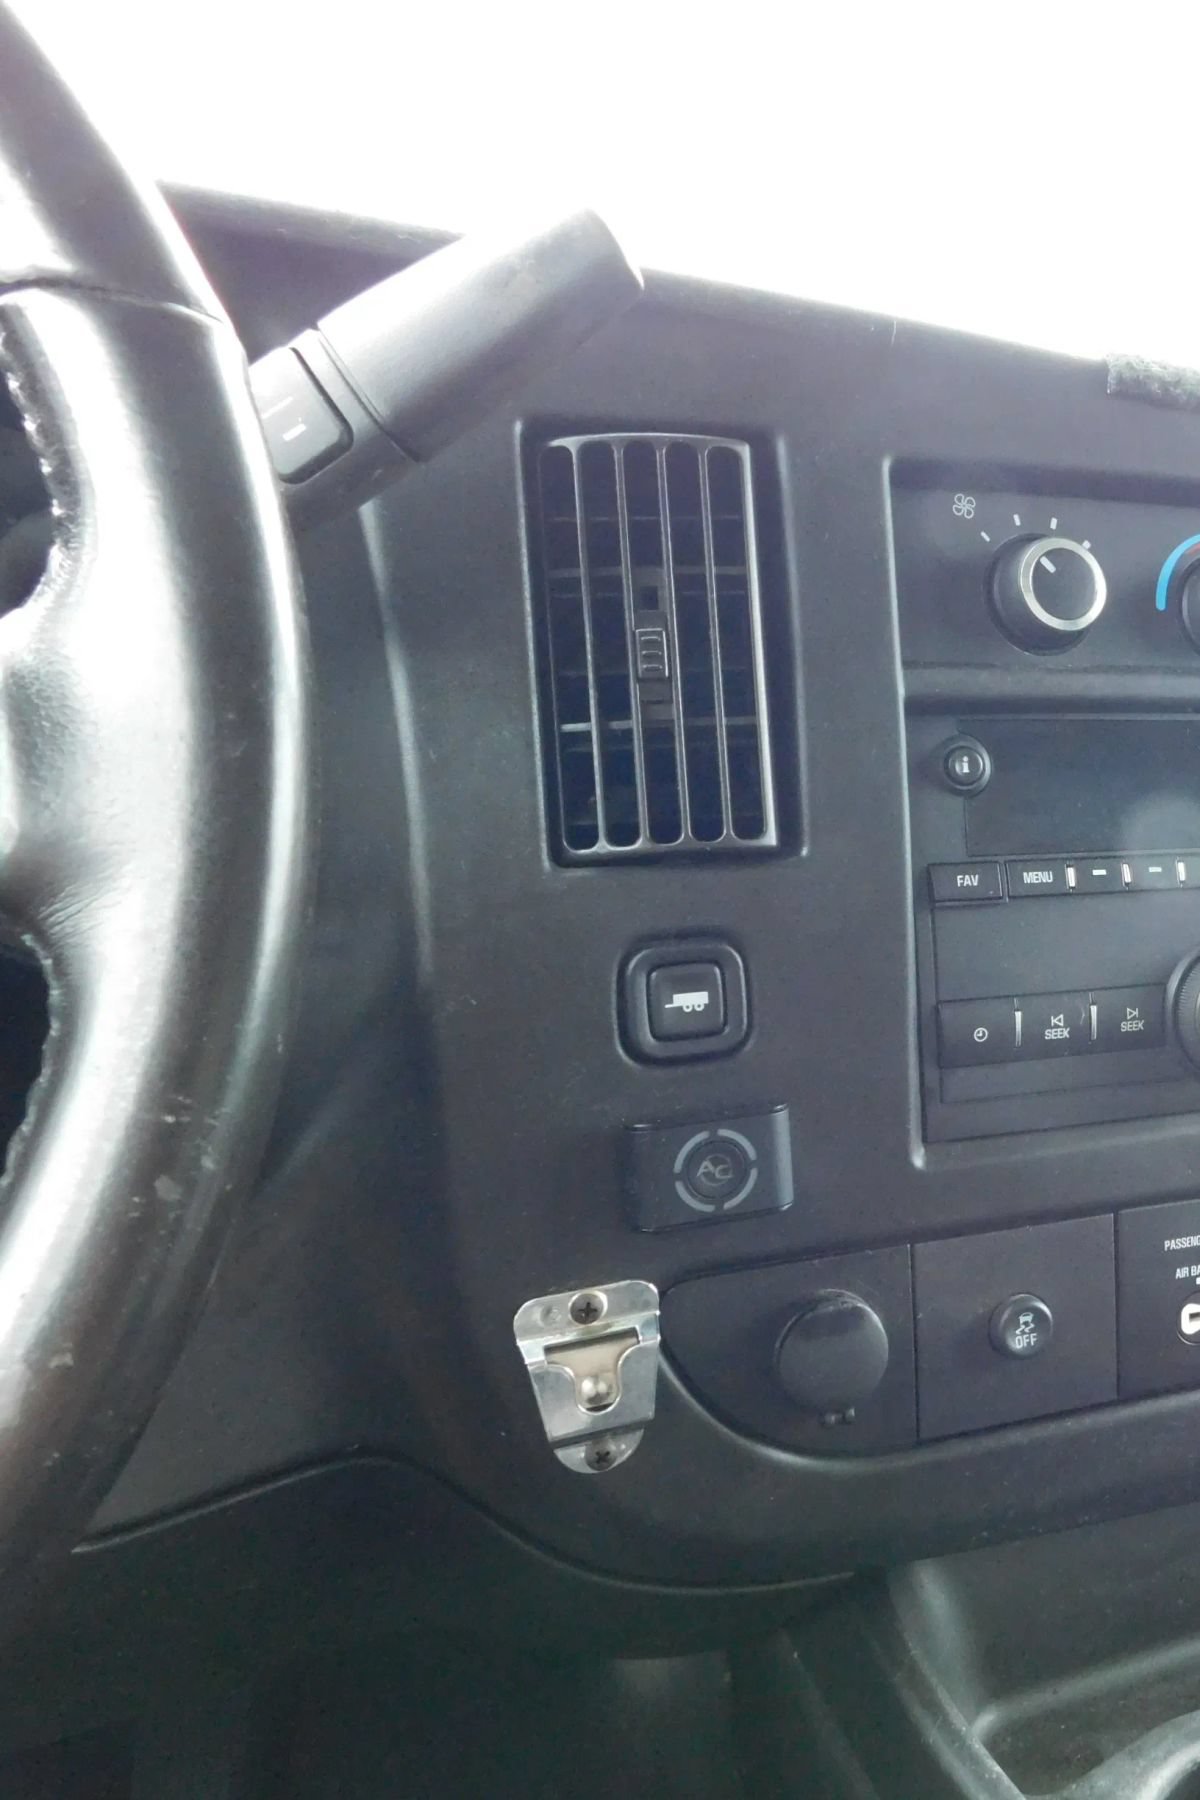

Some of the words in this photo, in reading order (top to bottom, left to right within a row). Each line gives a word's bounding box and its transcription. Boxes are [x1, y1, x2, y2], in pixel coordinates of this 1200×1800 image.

[956, 874, 979, 887] FAV
[1022, 871, 1053, 884] MENU
[1120, 1020, 1145, 1032] SEEK
[1044, 1027, 1070, 1040] SEEK
[1175, 1266, 1189, 1279] AIR
[1015, 1332, 1038, 1349] OFF
